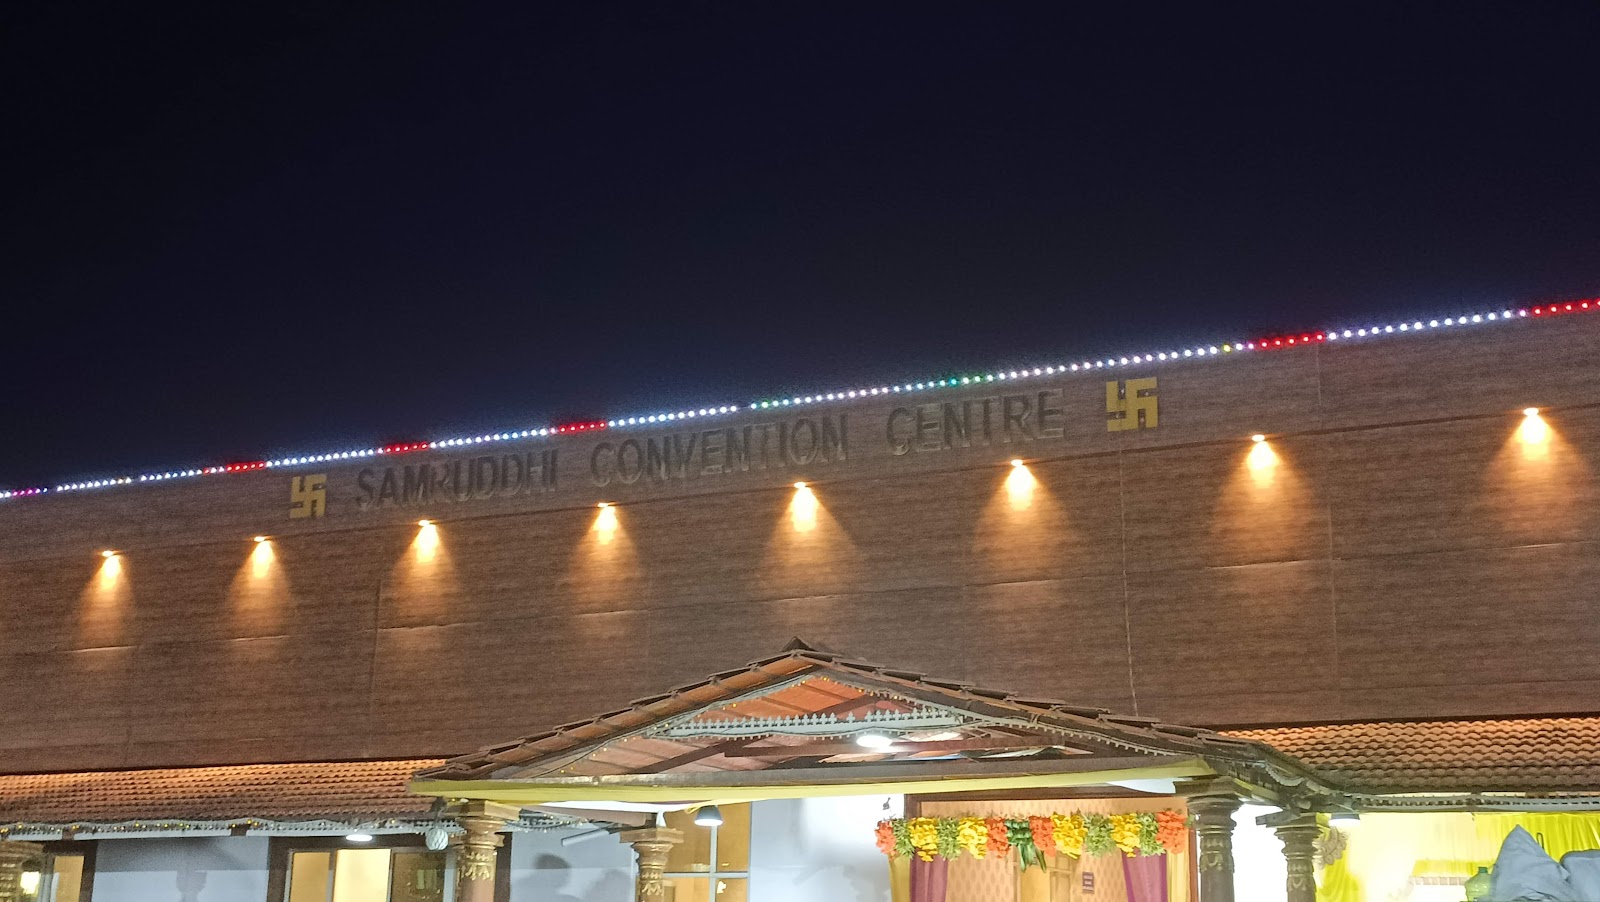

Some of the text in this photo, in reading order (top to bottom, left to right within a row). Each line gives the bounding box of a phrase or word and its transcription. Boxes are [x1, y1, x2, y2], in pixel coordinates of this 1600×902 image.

[356, 388, 1065, 510] SAMRUDDHI CONVENTION CENTRE
